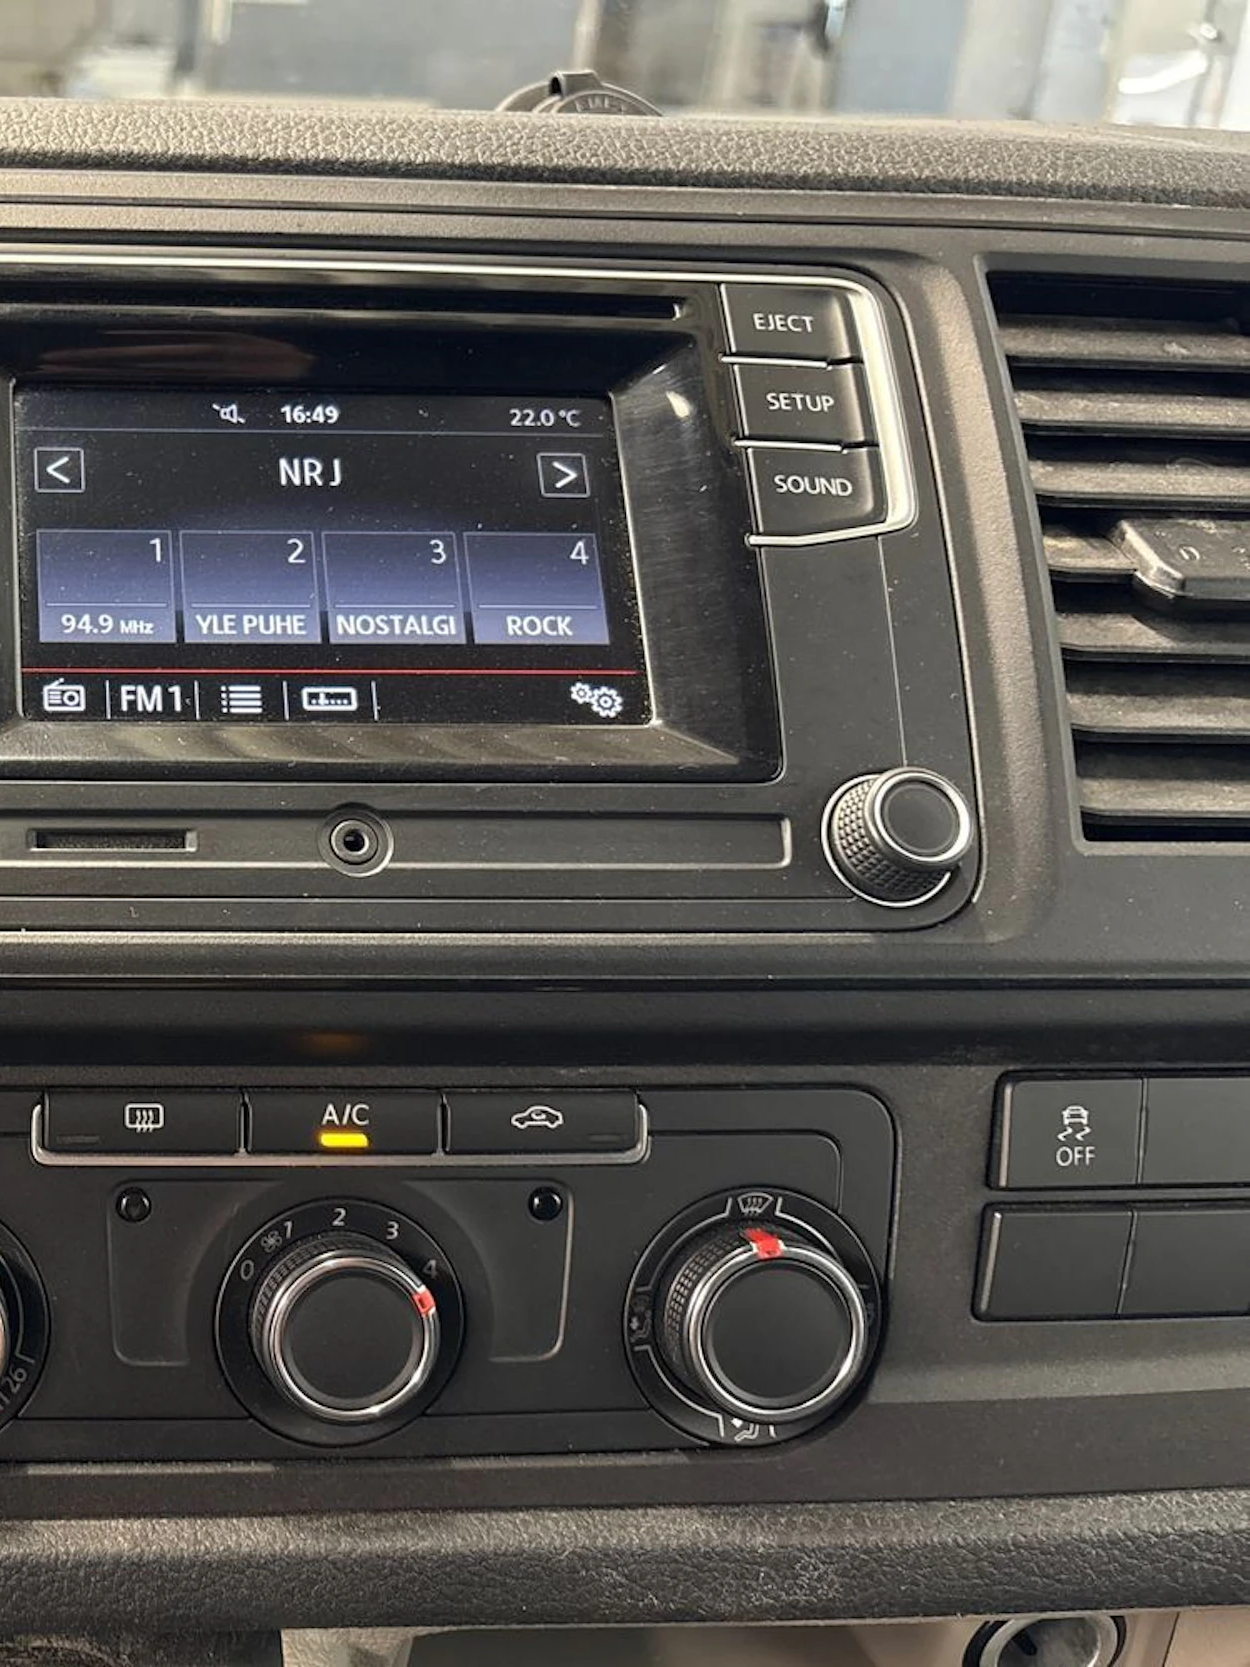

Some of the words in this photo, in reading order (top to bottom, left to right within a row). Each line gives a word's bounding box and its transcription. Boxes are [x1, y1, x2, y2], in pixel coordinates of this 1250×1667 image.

[754, 314, 812, 332] EJECT
[767, 393, 834, 411] SETUP
[281, 406, 339, 423] 16:49
[280, 458, 341, 486] NRJ
[775, 475, 852, 496] SOUND
[150, 538, 161, 562] 1
[288, 539, 305, 563] 2
[430, 540, 446, 564] 3
[570, 541, 588, 564] 4
[62, 614, 113, 634] 94.9
[120, 620, 153, 634] MHz
[196, 615, 237, 634] YLE
[243, 615, 306, 634] PUHE
[337, 615, 456, 635] NOSTALGI
[507, 616, 573, 635] ROCK
[323, 1104, 369, 1125] A/C
[1056, 1147, 1094, 1166] OFF
[283, 1220, 293, 1239] 1
[332, 1207, 347, 1227] 2
[385, 1221, 400, 1240] 3
[423, 1259, 438, 1278] 4
